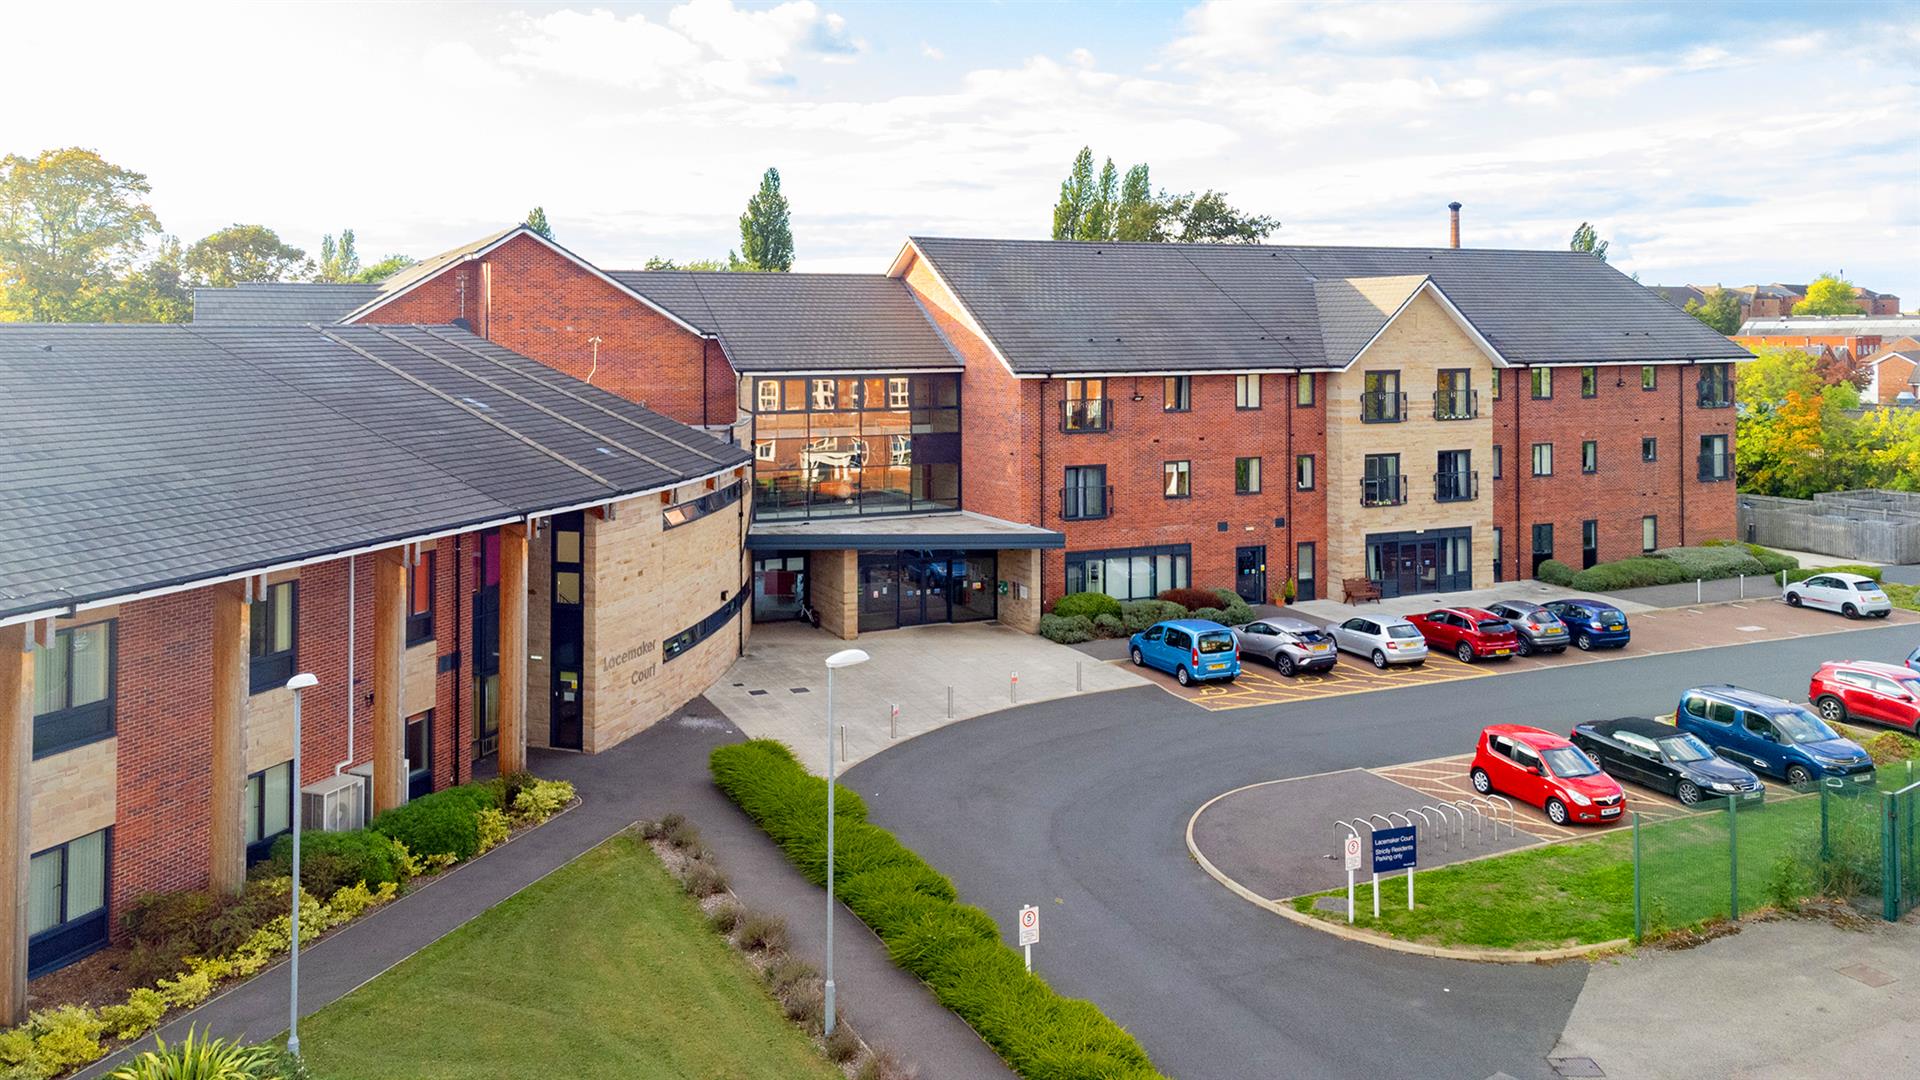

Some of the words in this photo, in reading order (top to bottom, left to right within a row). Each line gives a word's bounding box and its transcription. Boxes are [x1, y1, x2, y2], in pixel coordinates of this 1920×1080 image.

[603, 639, 656, 672] Lacemaker
[631, 663, 656, 685] Court
[1375, 837, 1399, 846] Lacemaker
[1375, 848, 1391, 856] Strictly
[1391, 845, 1413, 853] Residents
[1375, 854, 1393, 862] Parking
